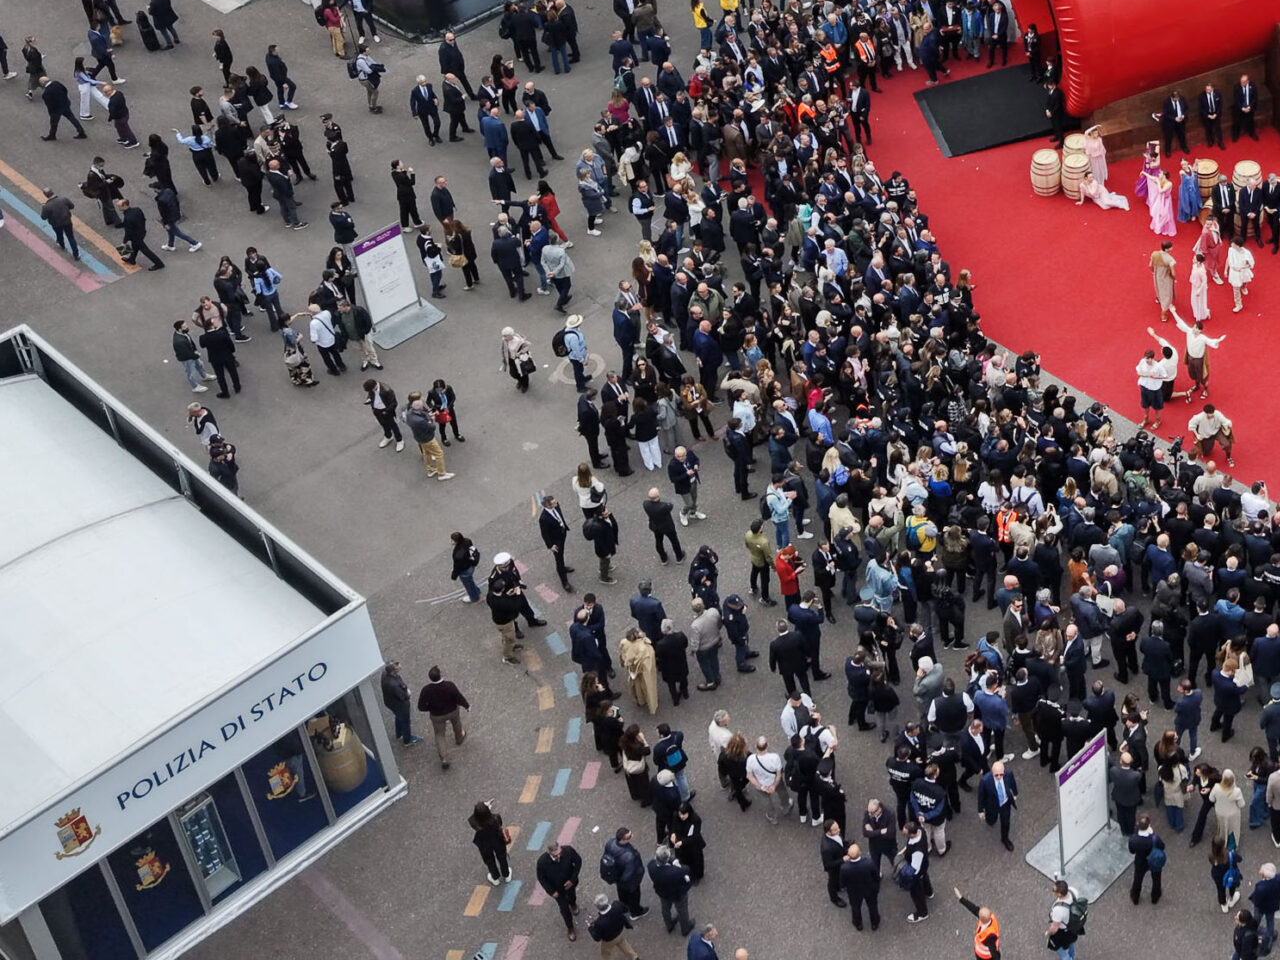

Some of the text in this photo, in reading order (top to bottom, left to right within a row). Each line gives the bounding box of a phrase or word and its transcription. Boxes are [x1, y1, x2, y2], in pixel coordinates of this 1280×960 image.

[116, 661, 329, 811] POLIZIA DI STATO
